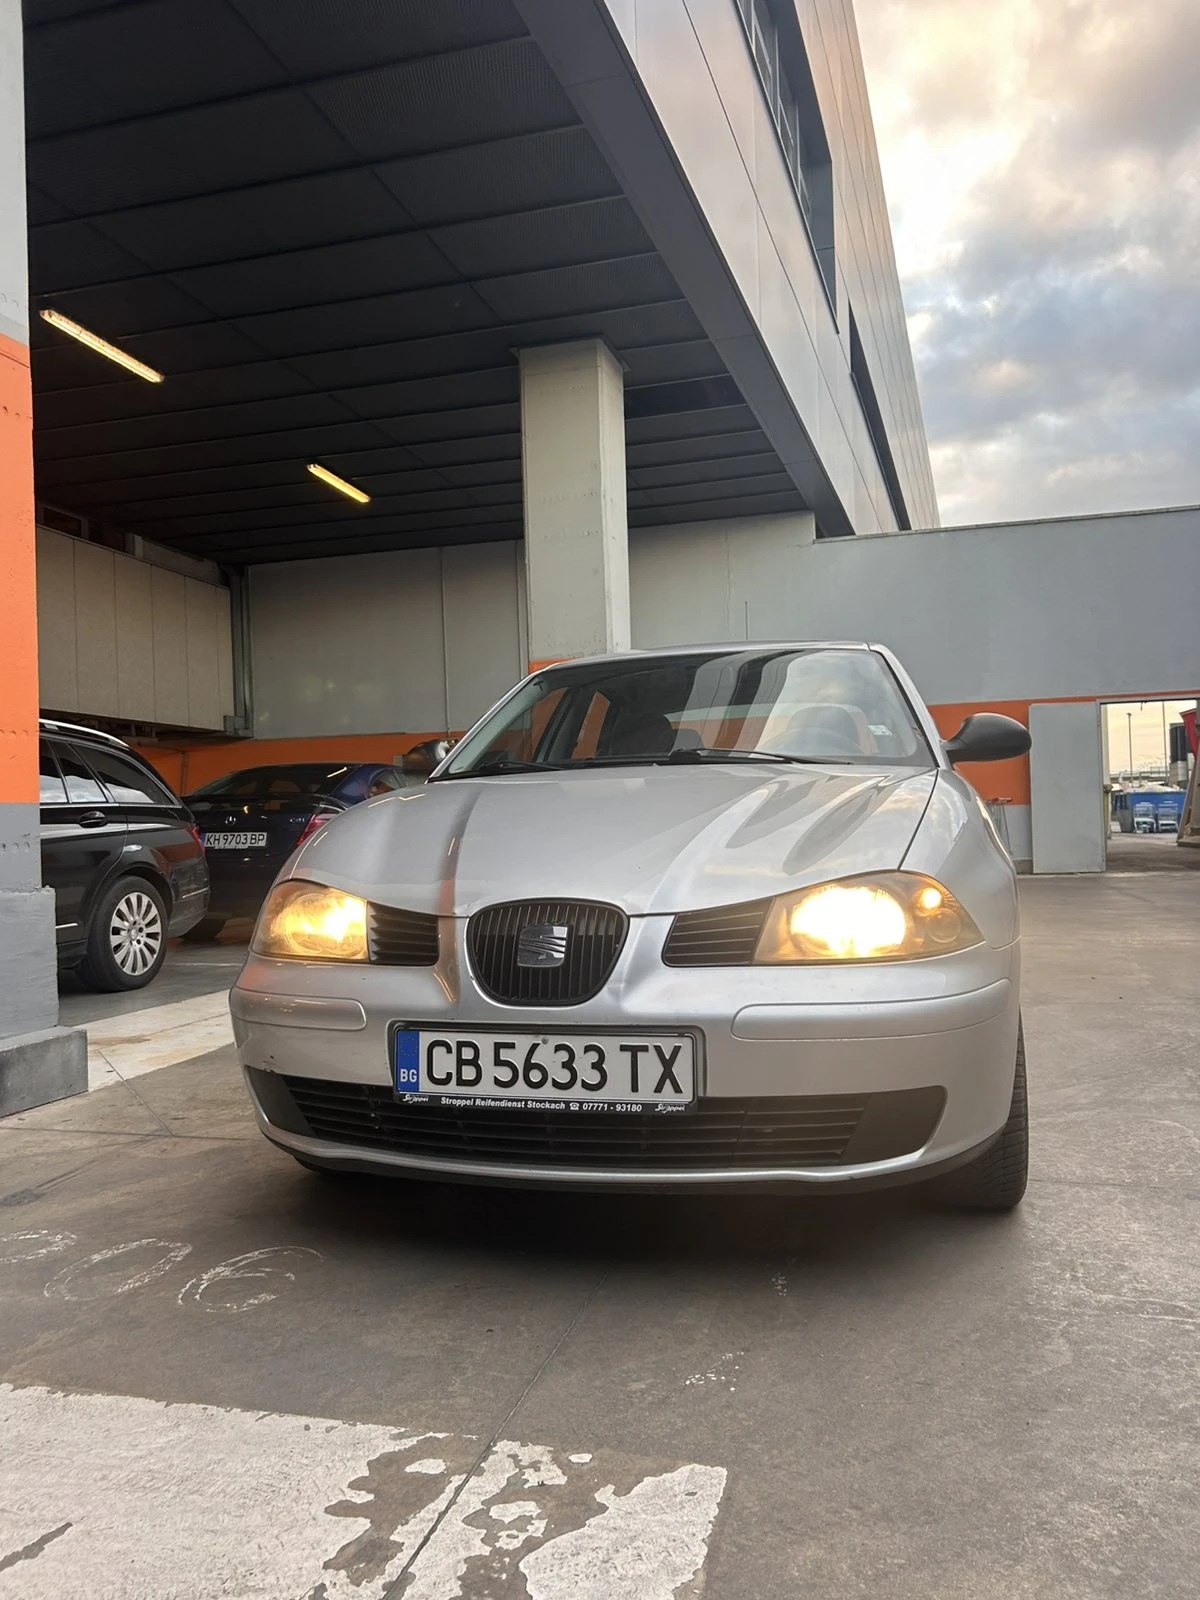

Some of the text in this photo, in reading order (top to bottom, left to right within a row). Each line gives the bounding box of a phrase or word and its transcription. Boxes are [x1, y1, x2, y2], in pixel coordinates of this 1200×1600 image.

[206, 834, 265, 845] KH 9703 BP
[427, 1039, 683, 1094] CB 5633 TX
[400, 1069, 417, 1082] BG
[441, 1097, 474, 1107] Stroppel
[475, 1098, 525, 1108] Reifendienst
[527, 1101, 566, 1110] Stockach
[582, 1102, 608, 1111] 07771
